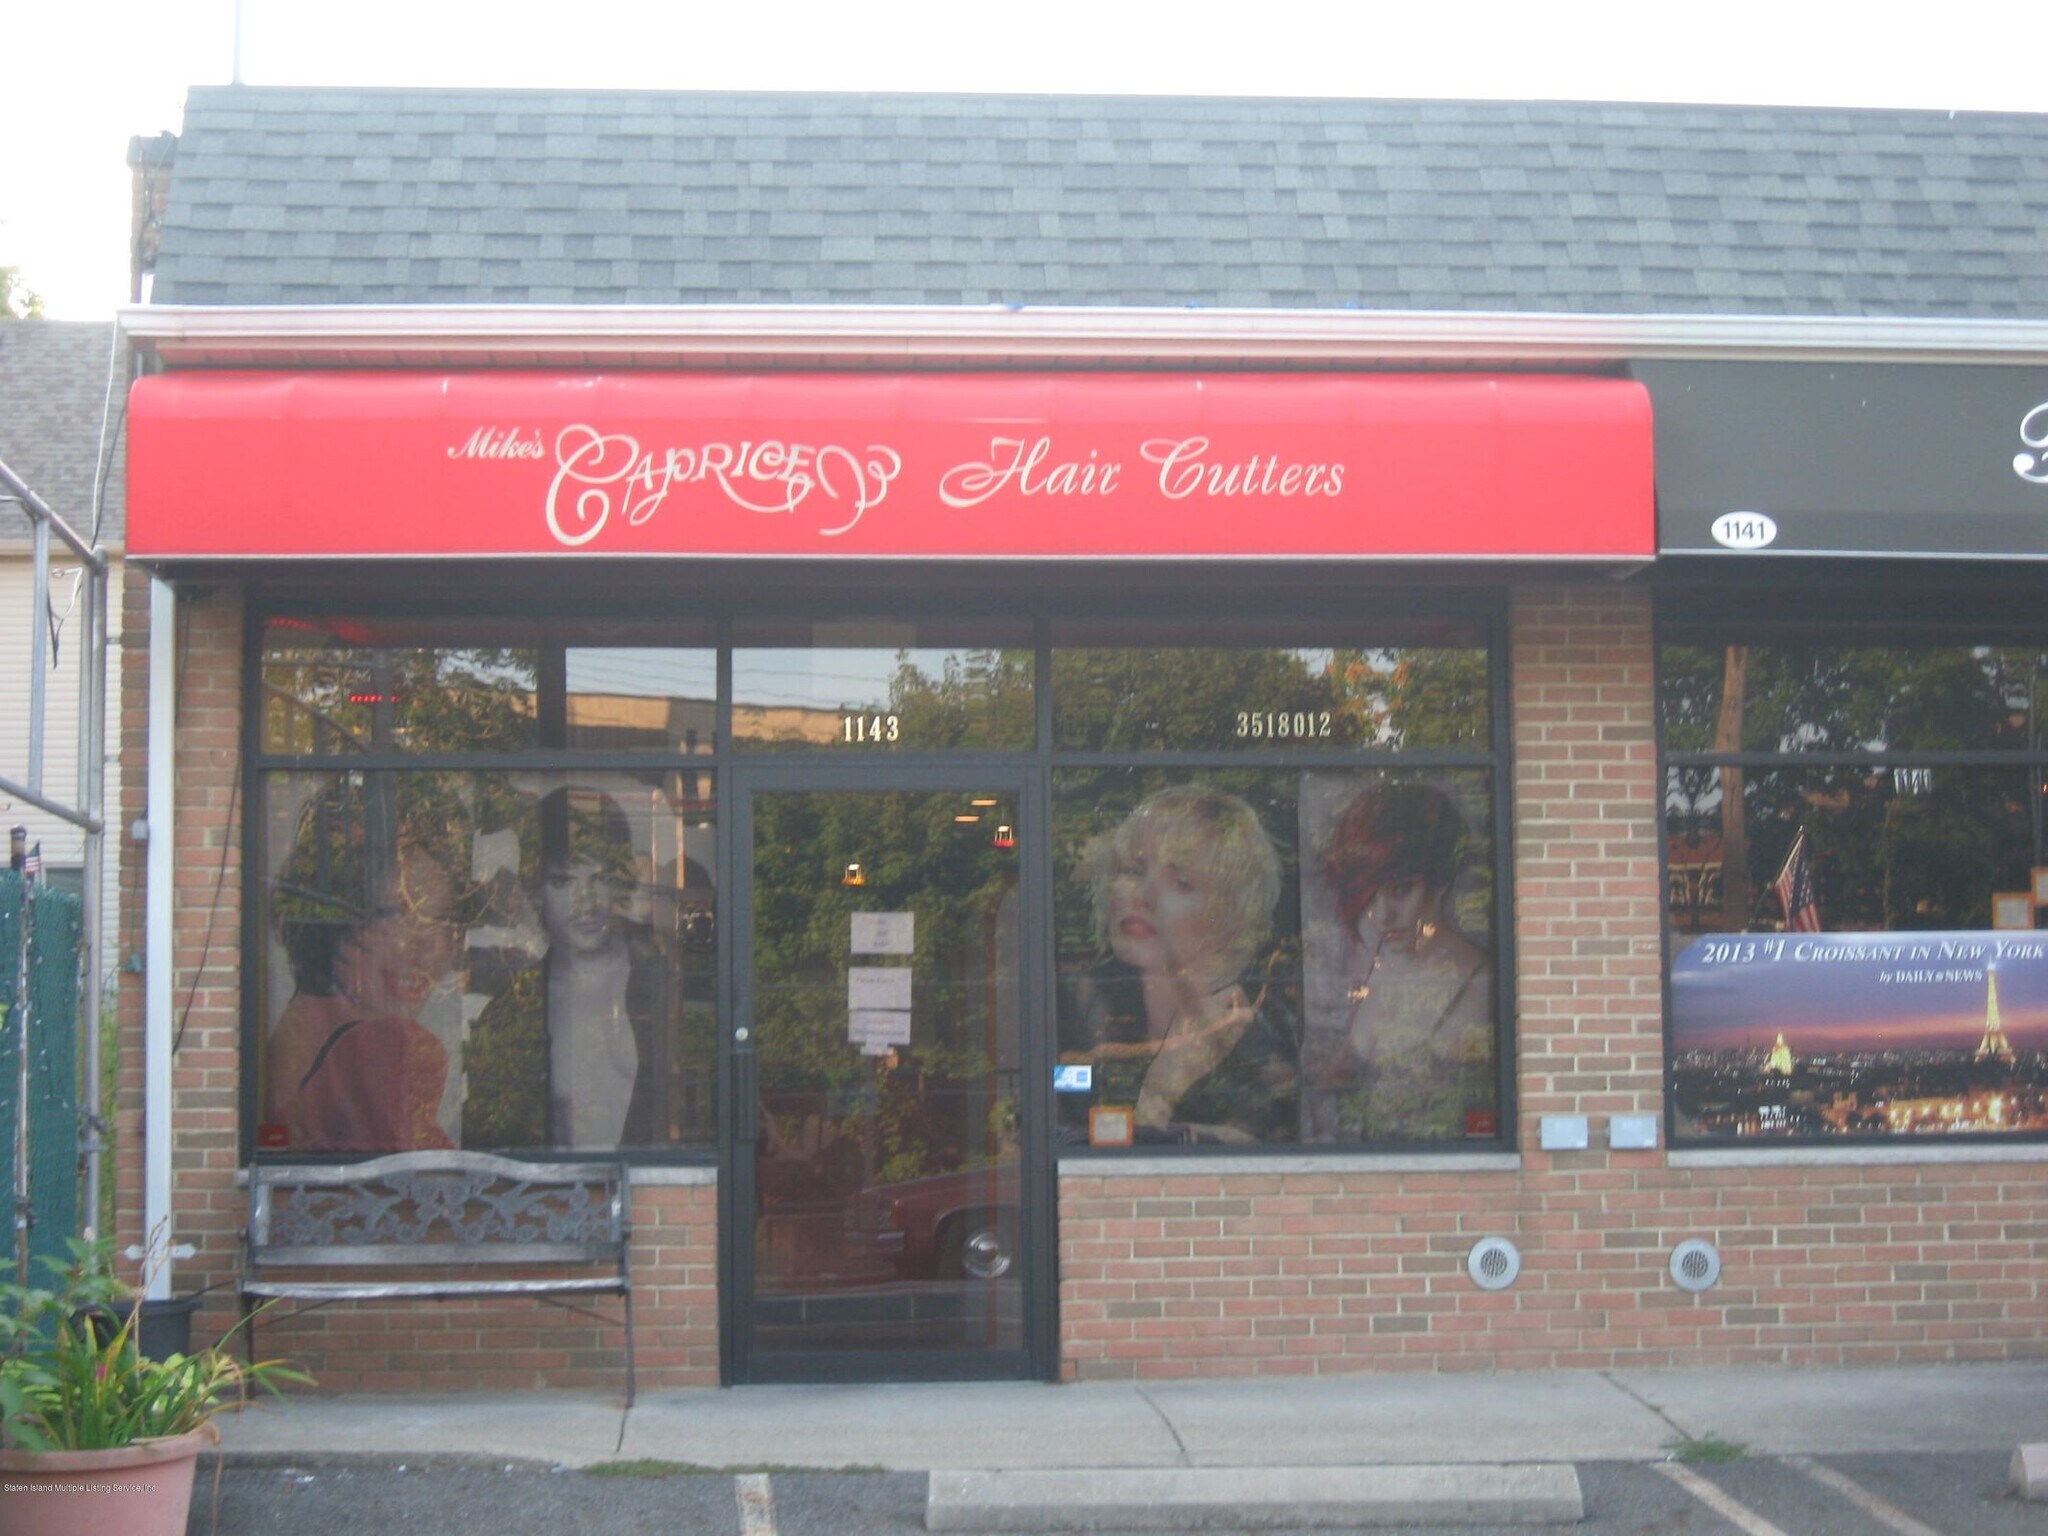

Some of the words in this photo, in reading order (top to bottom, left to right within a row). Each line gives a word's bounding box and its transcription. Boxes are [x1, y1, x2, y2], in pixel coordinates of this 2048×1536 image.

[447, 425, 545, 459] Mike's
[938, 435, 1121, 508] Hair
[1139, 435, 1346, 500] Cutters
[1723, 521, 1765, 540] 1141
[844, 715, 900, 742] 1143
[1236, 711, 1332, 738] 3518012
[1702, 942, 1757, 964] 2013
[1763, 939, 1787, 962] #1
